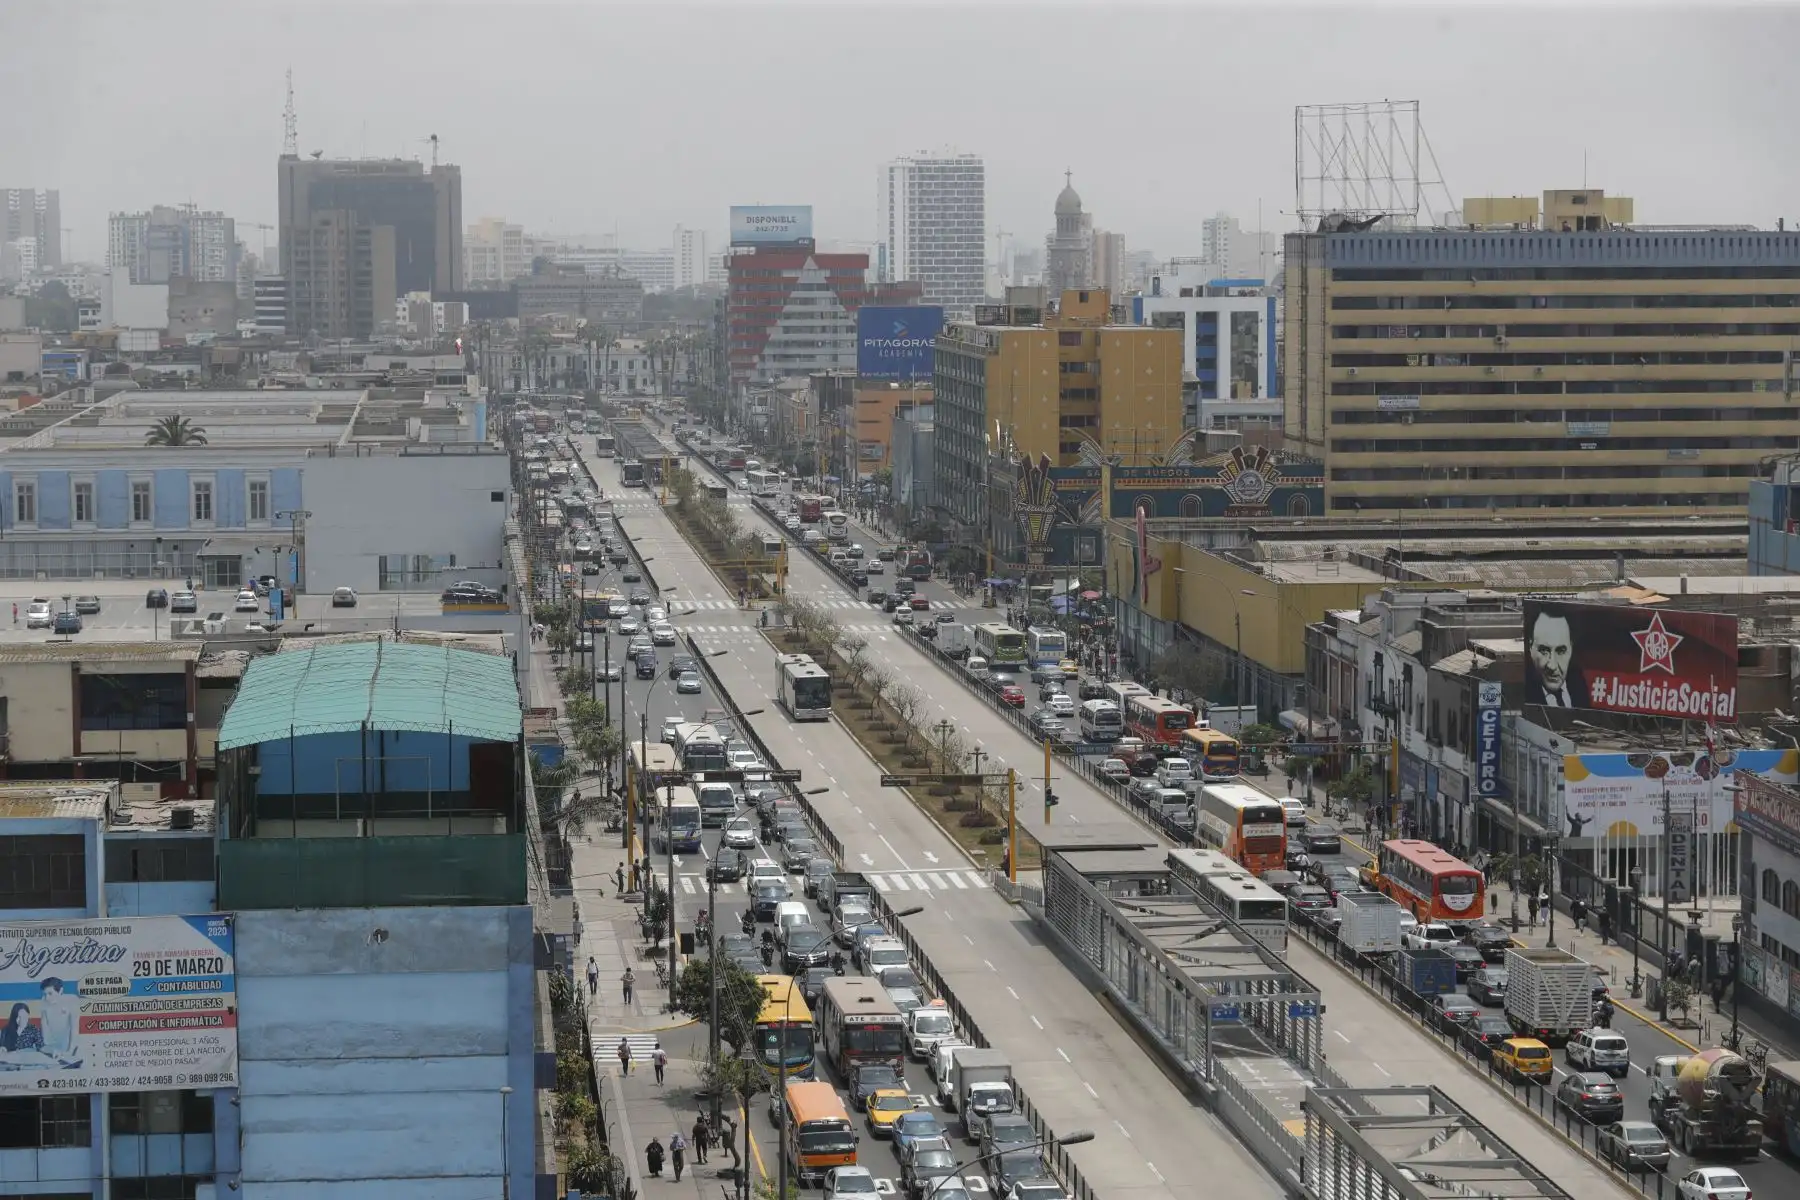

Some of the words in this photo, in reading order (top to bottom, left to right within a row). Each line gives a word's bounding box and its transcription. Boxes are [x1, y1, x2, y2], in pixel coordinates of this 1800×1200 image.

[746, 216, 797, 224] DISPONIBLE
[864, 338, 936, 348] PITAGORAS
[1123, 469, 1137, 477] DE
[1146, 468, 1190, 477] JUEGOS
[1591, 676, 1736, 717] #JusticiaSocial
[1481, 709, 1497, 792] CETPRO
[1671, 833, 1686, 902] DENTAL
[25, 928, 59, 938] SUPERIOR
[59, 926, 103, 937] TECNOLÓGICO
[104, 924, 132, 935] PÚBLICO
[207, 927, 227, 936] 2020
[0, 936, 127, 978] Argentina
[133, 960, 151, 977] 29
[155, 959, 172, 976] DE
[176, 957, 224, 975] MARZO
[85, 977, 94, 986] NO
[95, 977, 104, 985] SE
[105, 976, 123, 984] PAGA
[157, 980, 222, 992] CONTABILIDAD
[80, 986, 129, 996] MENSUALIDAD!
[92, 1000, 164, 1013] ADMINISTRACIÓN
[165, 1001, 177, 1010] DE
[178, 998, 223, 1009] EMPRESAS
[98, 1018, 157, 1031] COMPUTACIÓN
[159, 1019, 165, 1028] E
[166, 1016, 223, 1028] INFORMÁTICA
[103, 1040, 138, 1049] CARRERA
[140, 1038, 189, 1047] PROFESIONAL
[192, 1037, 197, 1045] 3
[198, 1036, 220, 1044] AÑOS
[140, 1048, 172, 1057] NOMBRE
[174, 1048, 184, 1056] DE
[186, 1047, 195, 1055] LA
[104, 1060, 133, 1068] CARNET
[135, 1059, 146, 1067] DE
[147, 1058, 173, 1067] MEDIO
[174, 1057, 200, 1065] PASAJE
[52, 1079, 87, 1089] 423-0142
[219, 1072, 234, 1082] 296
